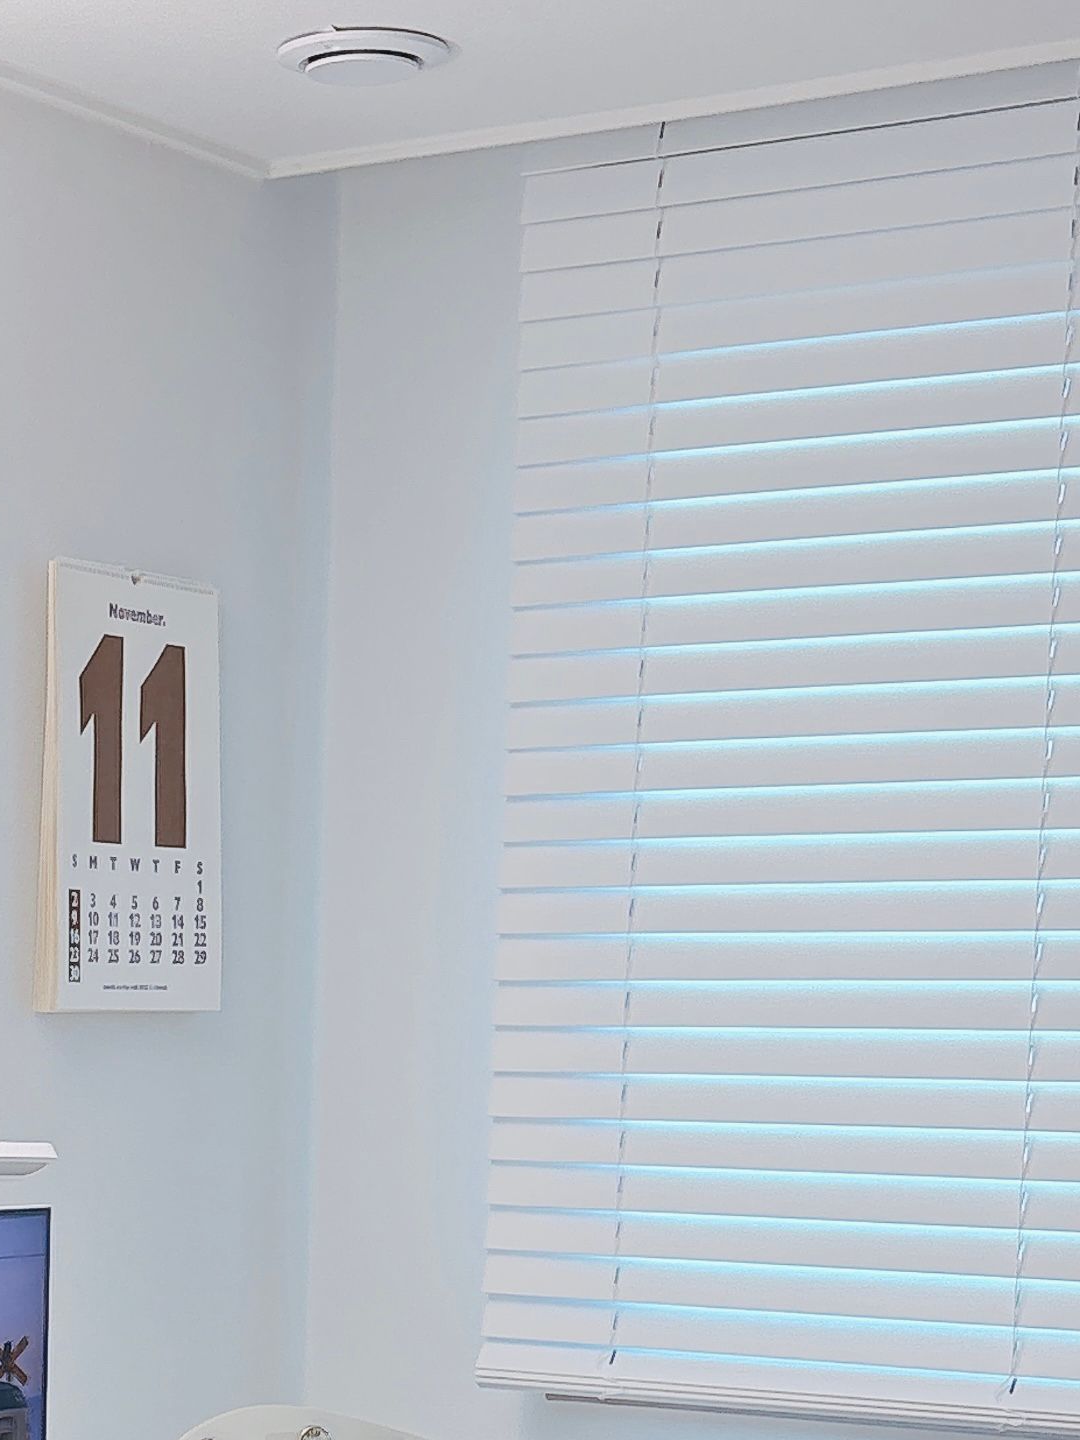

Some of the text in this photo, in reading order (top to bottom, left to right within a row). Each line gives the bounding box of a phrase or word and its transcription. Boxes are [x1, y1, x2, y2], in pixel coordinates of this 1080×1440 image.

[79, 633, 187, 849] 11
[72, 854, 78, 868] S
[110, 857, 117, 870] T
[130, 858, 140, 872] W
[153, 860, 160, 872] T
[175, 861, 181, 873] F
[197, 862, 203, 875] S
[197, 880, 203, 894] 1
[90, 893, 96, 908] 3
[110, 894, 117, 909] 4
[131, 895, 138, 910] 5
[152, 896, 159, 911] 6
[174, 896, 181, 911] 7
[196, 897, 204, 912] 8
[88, 911, 99, 926] 10
[108, 912, 119, 927] 11
[129, 913, 141, 928] 12
[150, 914, 162, 929] 13
[172, 914, 184, 929] 14
[194, 914, 207, 930] 15
[88, 929, 99, 945] 17
[108, 930, 120, 945] 18
[129, 931, 141, 946] 19
[150, 931, 162, 946] 20
[172, 932, 183, 947] 21
[194, 932, 207, 947] 22
[88, 947, 99, 963] 24
[108, 948, 119, 963] 25
[129, 949, 141, 964] 26
[150, 949, 162, 964] 27
[172, 949, 185, 964] 28
[194, 949, 207, 965] 29
